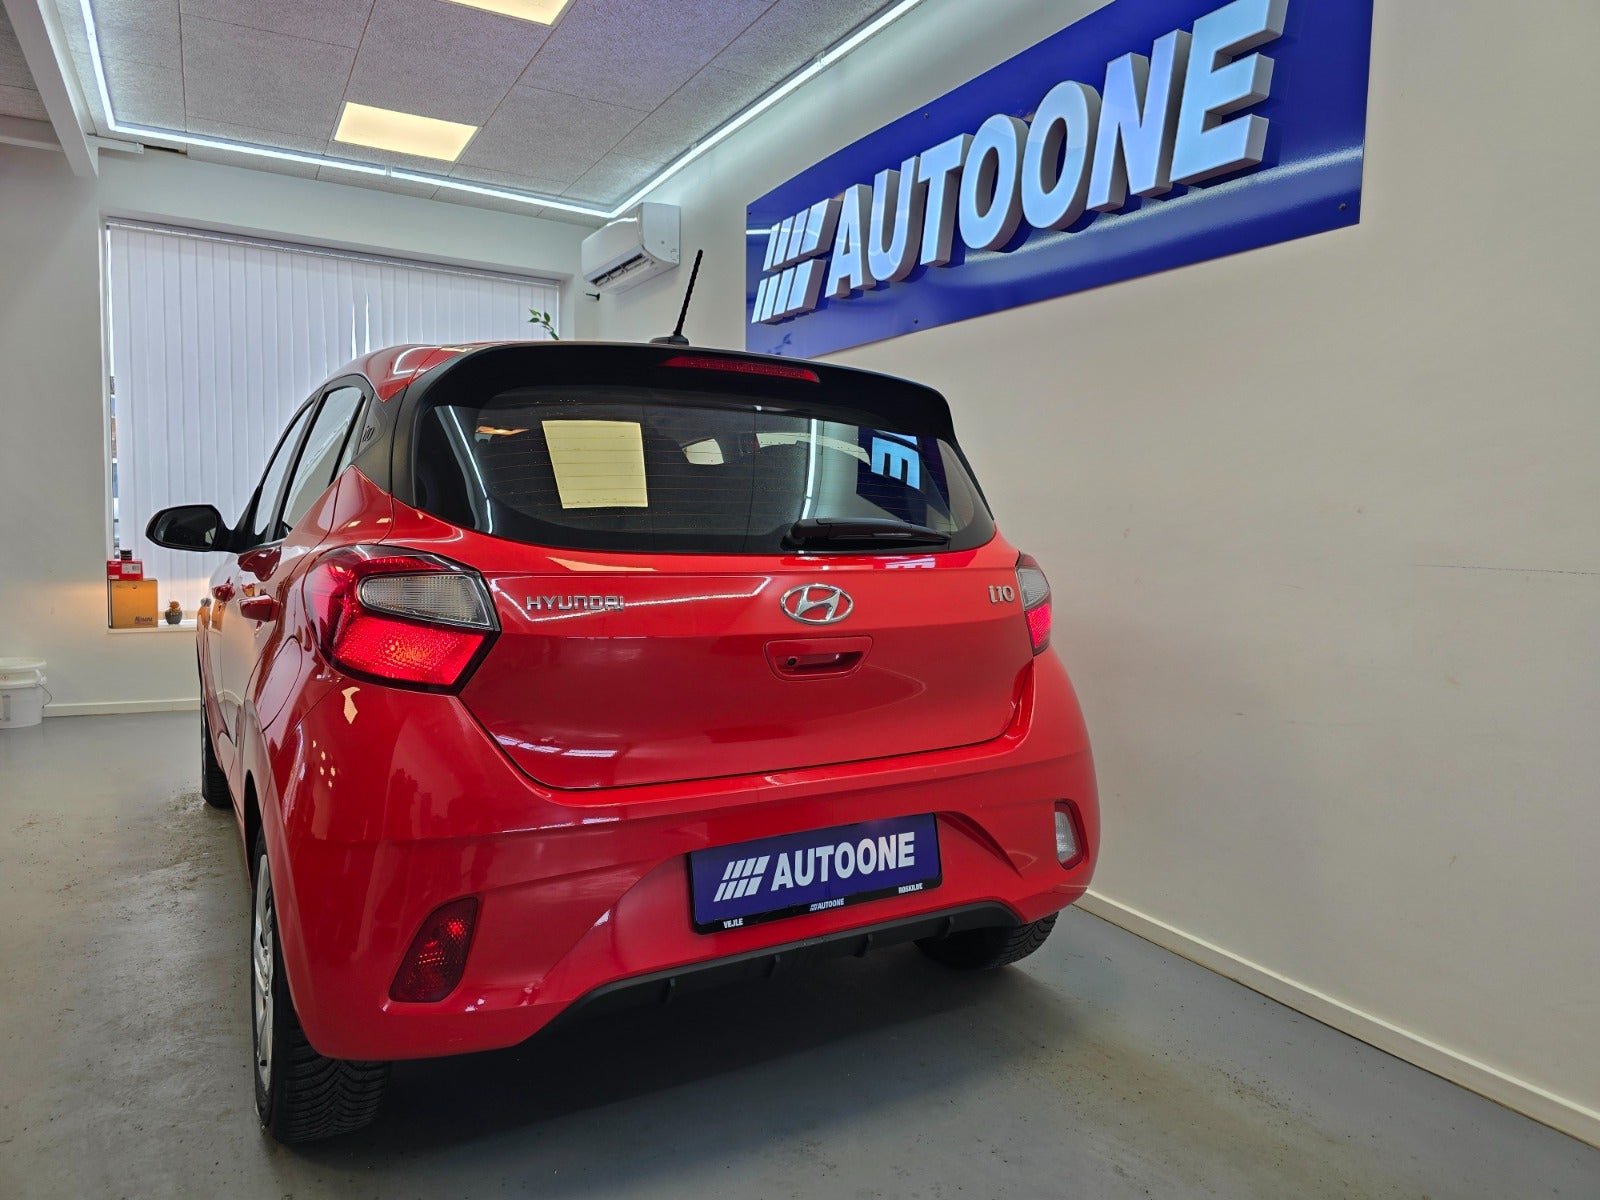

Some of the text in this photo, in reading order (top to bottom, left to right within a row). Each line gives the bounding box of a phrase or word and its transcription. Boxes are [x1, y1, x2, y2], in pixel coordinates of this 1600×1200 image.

[825, 0, 1286, 298] AUTOONE
[526, 595, 624, 611] HYUNDAI
[770, 832, 915, 892] AUTOONE
[818, 897, 845, 910] AUTOONE
[723, 917, 744, 929] VEJLE
